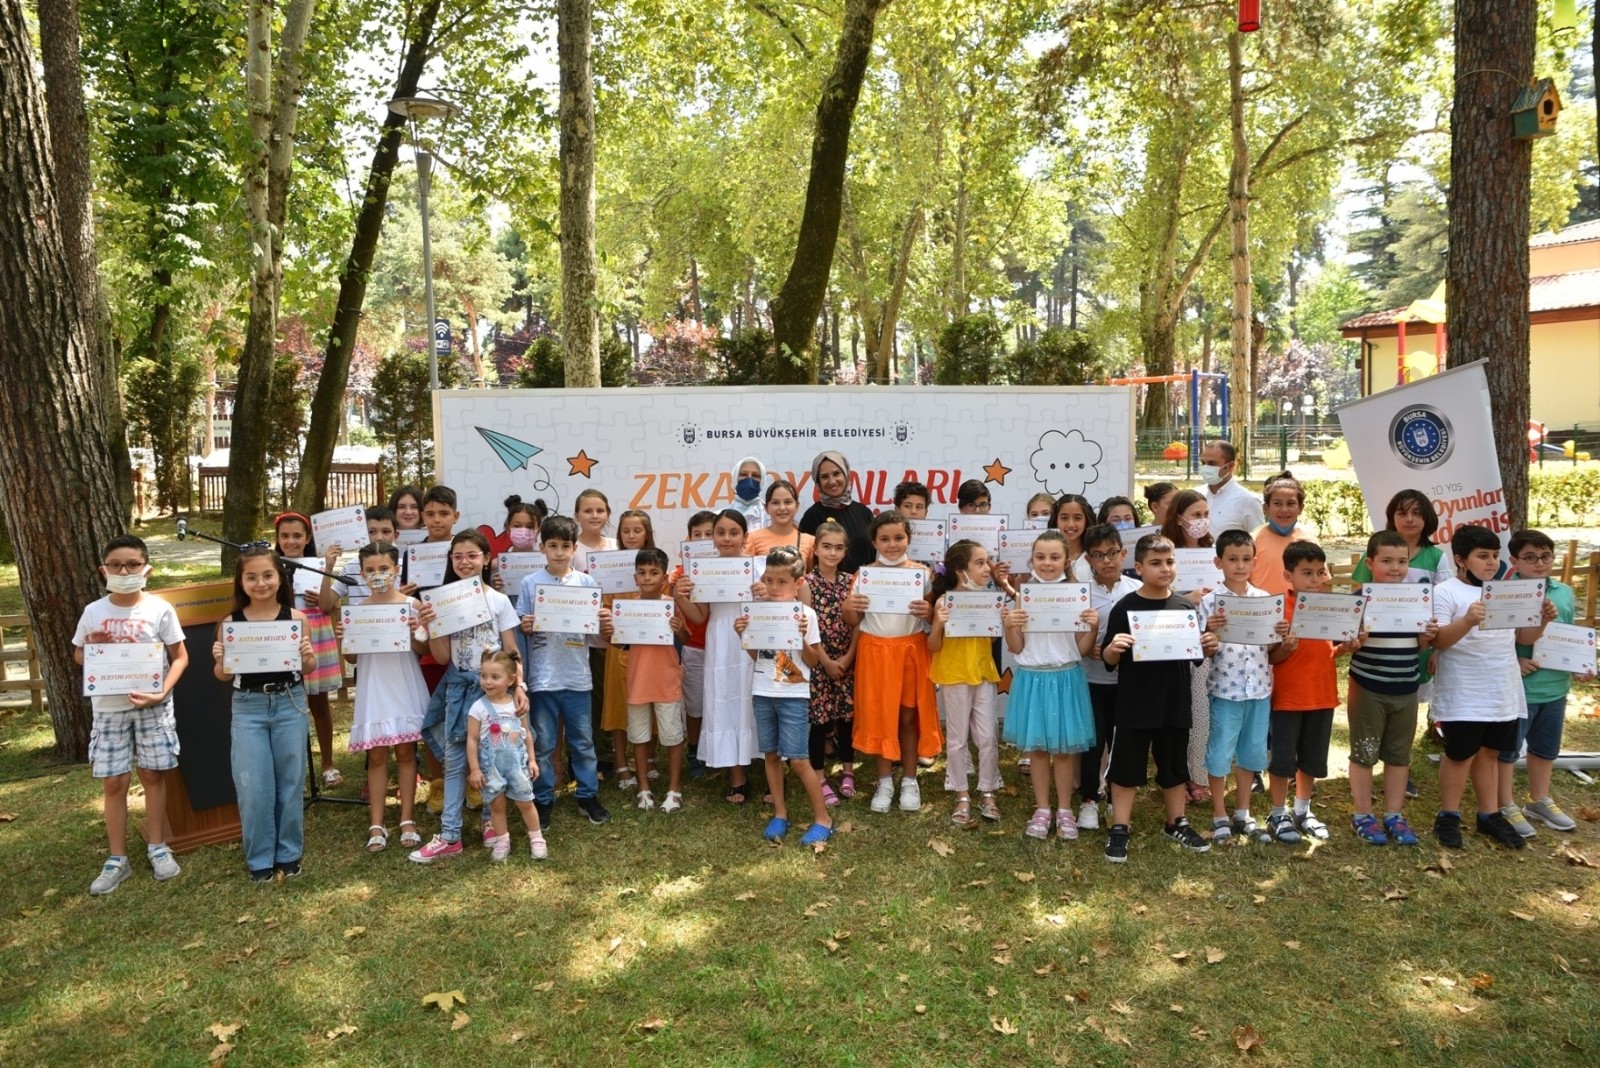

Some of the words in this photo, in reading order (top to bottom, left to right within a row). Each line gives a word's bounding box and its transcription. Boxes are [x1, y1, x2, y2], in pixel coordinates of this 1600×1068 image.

[1403, 411, 1427, 423] BURSA
[706, 430, 743, 439] BURSA
[748, 427, 817, 440] BÜYÜKŞEHİR
[823, 426, 886, 438] BELEDİYESİ
[629, 472, 736, 510] ZEKA
